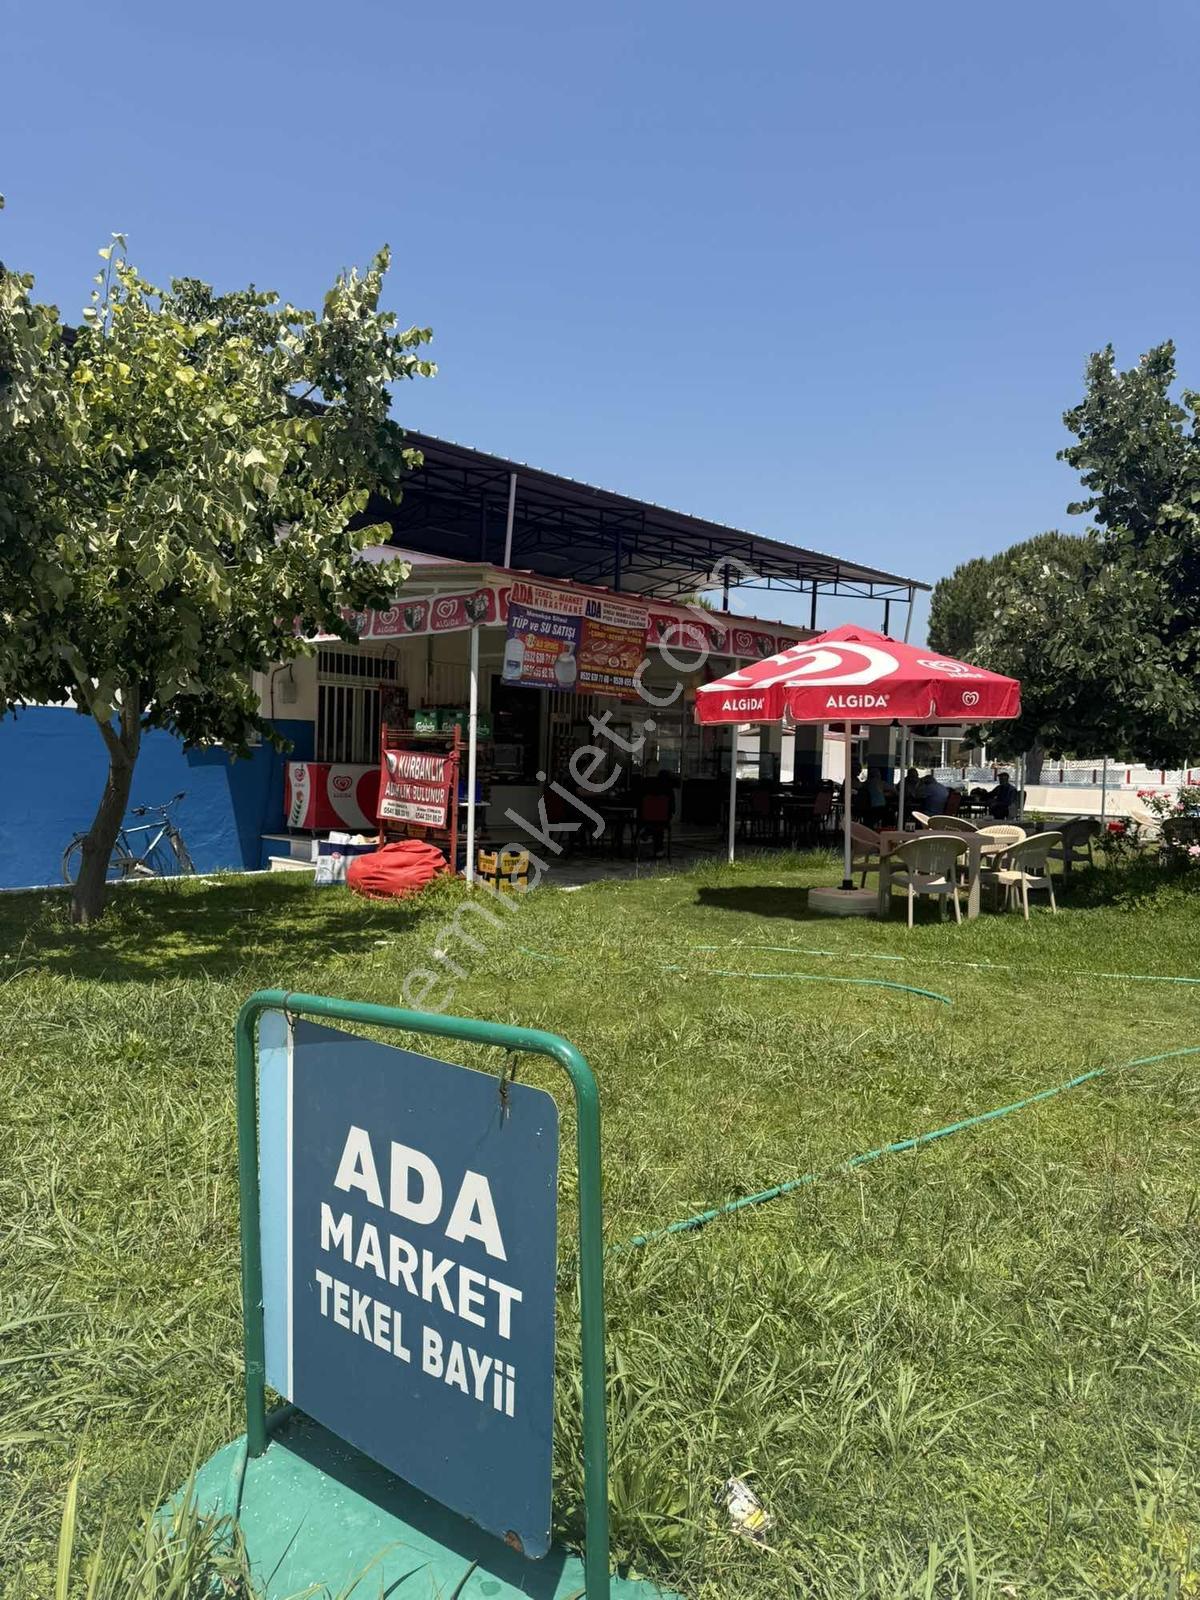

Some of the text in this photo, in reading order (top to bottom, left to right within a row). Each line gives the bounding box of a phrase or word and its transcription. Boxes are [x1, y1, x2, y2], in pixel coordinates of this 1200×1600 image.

[512, 582, 533, 604] ADA
[585, 599, 602, 619] ADA
[512, 615, 529, 630] TÜP
[530, 622, 539, 632] ve
[540, 621, 551, 633] SU
[398, 754, 445, 782] KURBANLIK
[334, 1124, 508, 1262] ADA
[321, 1201, 523, 1340] MARKET
[315, 1268, 411, 1364] TEKEL
